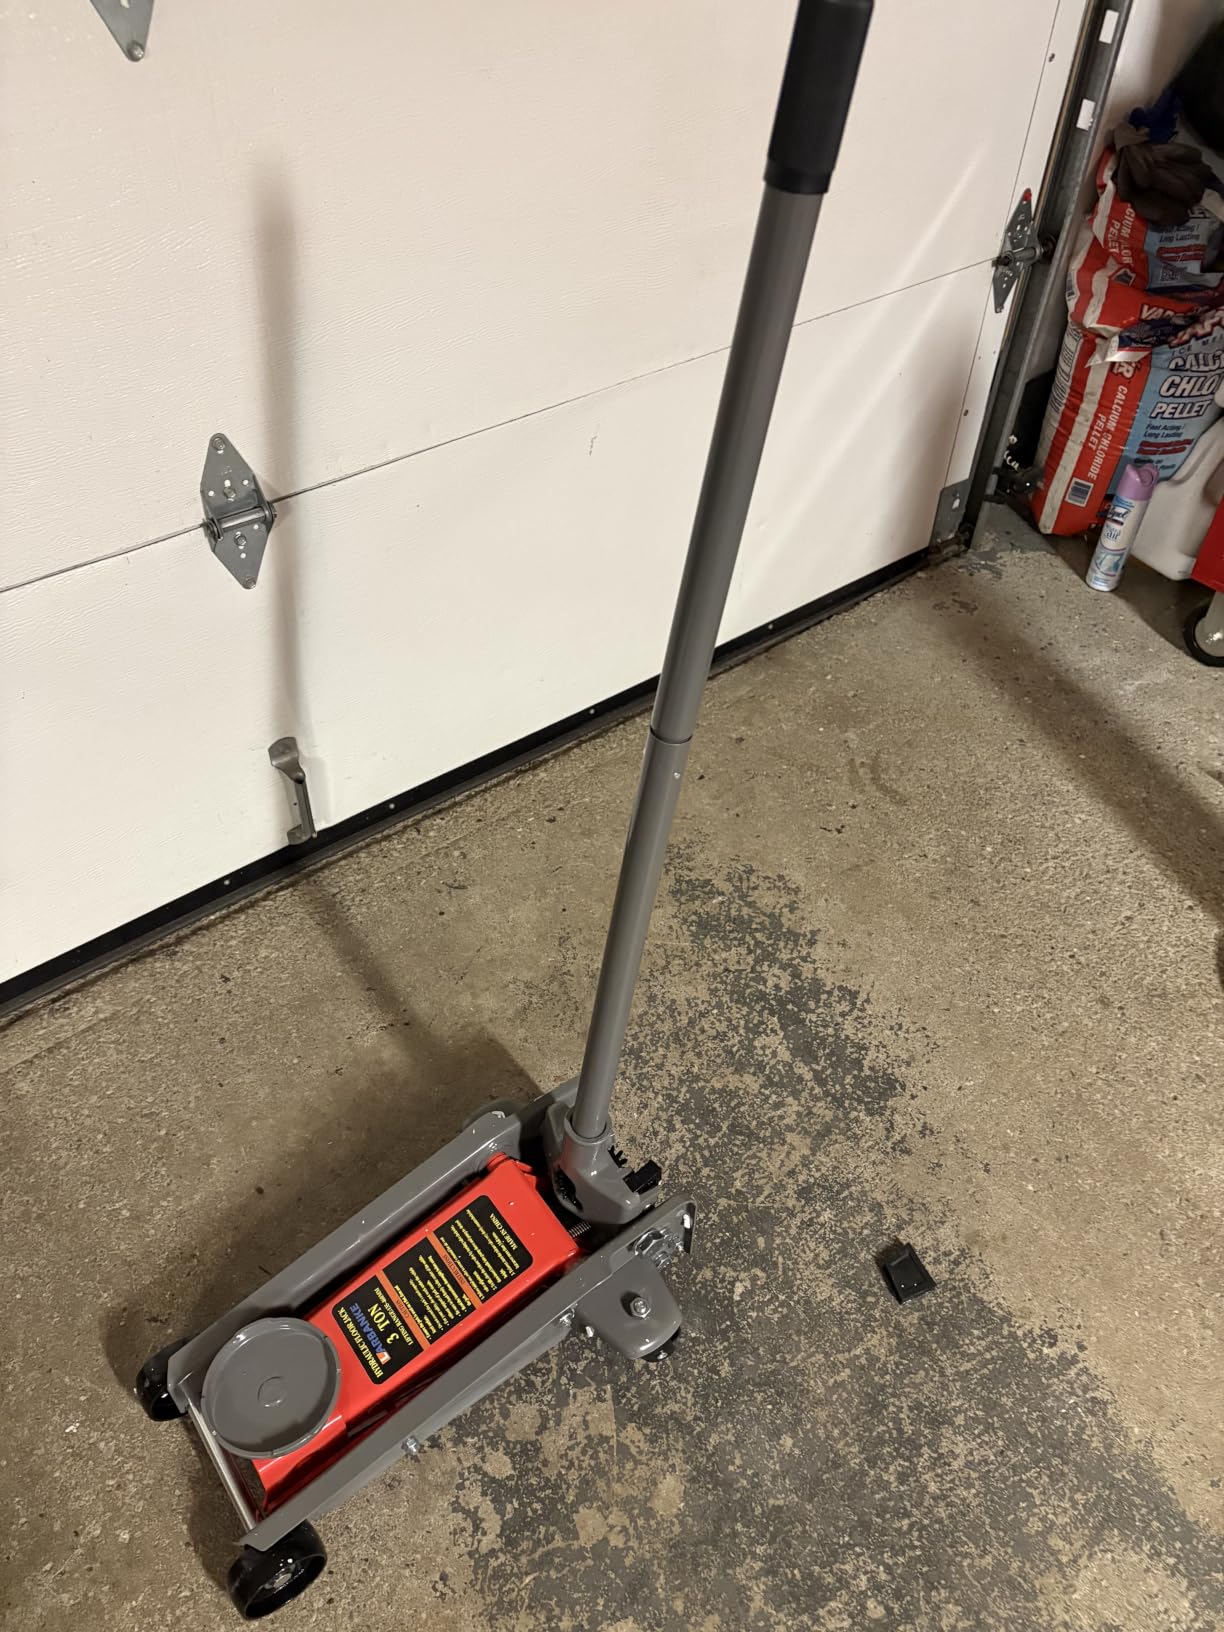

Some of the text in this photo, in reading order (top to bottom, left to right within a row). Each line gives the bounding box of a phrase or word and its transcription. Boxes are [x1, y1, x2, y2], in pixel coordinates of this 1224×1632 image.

[1149, 400, 1212, 419] PELLET
[1087, 385, 1128, 480] CALCIUM CHLORIDE
[1088, 413, 1107, 451] PELLET
[336, 1306, 384, 1378] HYDRAULIC FLOOR JACK
[366, 1301, 400, 1345] 3 TON
[397, 1324, 414, 1346] LIFTING
